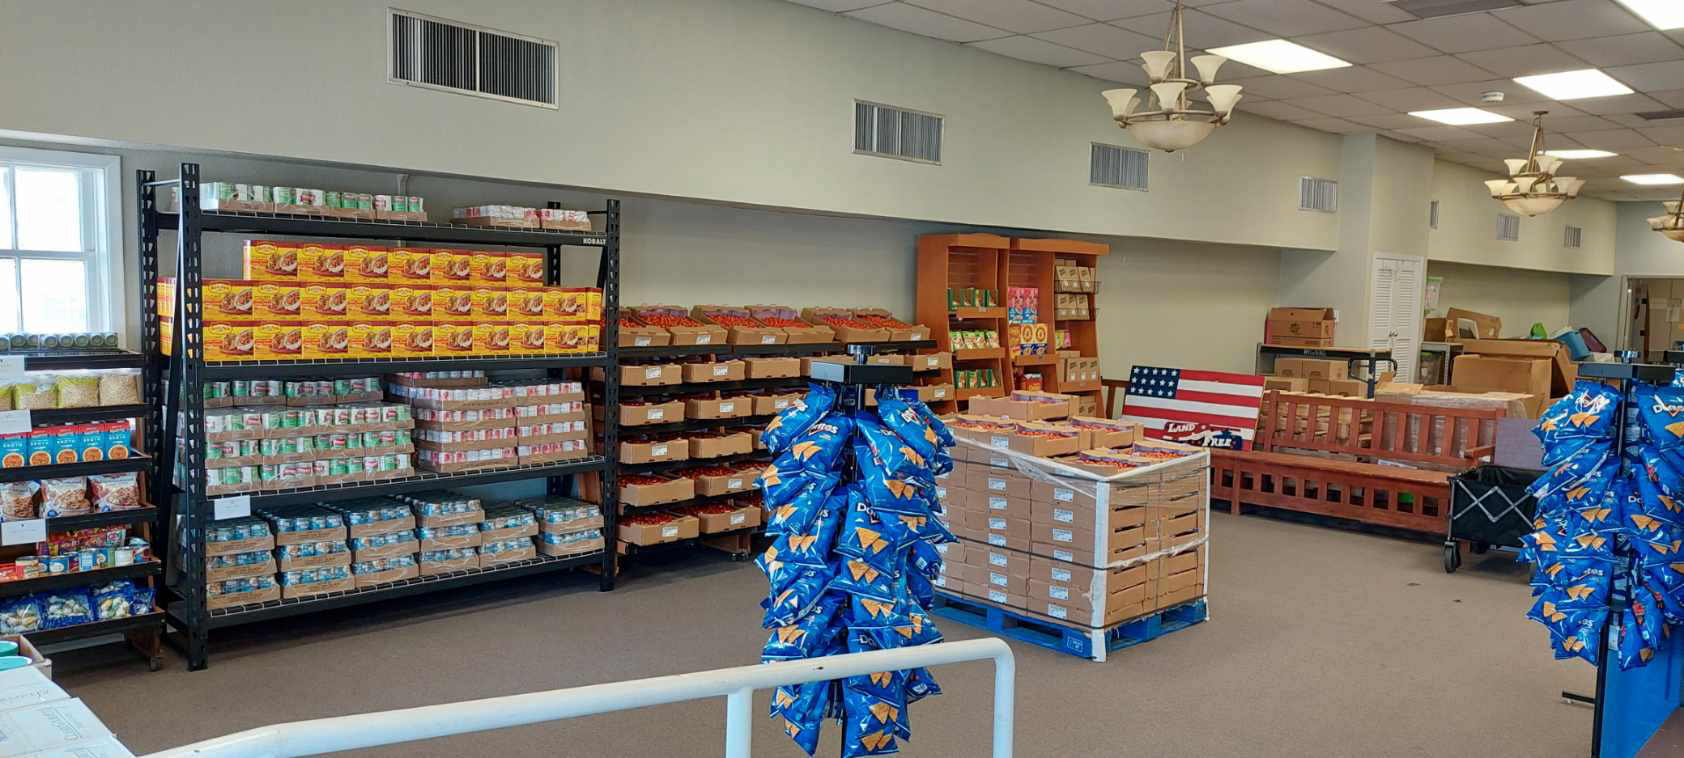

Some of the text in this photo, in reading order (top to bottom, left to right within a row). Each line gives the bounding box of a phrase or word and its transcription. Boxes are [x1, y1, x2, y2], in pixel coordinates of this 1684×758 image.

[583, 237, 606, 245] KOBALT
[1168, 423, 1196, 433] LAND
[1202, 434, 1233, 447] FREE
